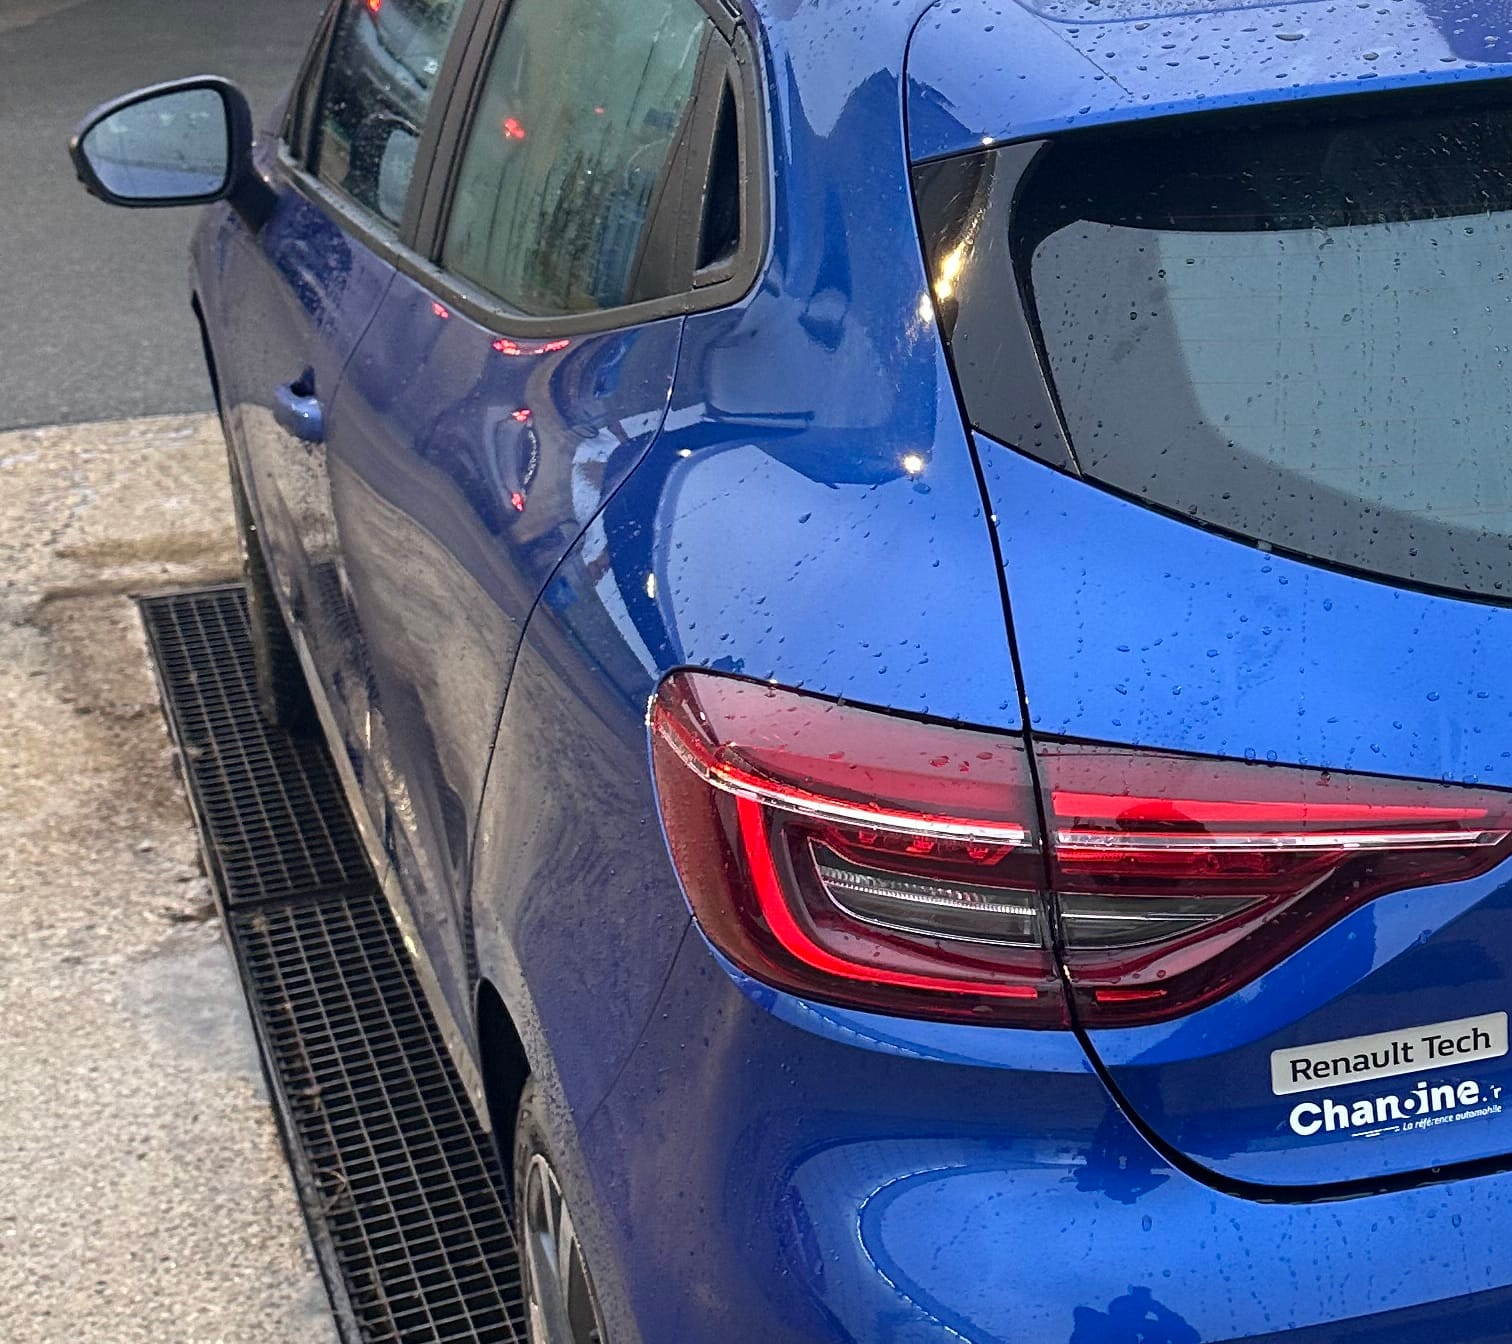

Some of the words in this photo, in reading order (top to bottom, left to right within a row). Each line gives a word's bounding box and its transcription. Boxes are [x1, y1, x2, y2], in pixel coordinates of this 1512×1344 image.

[1289, 1041, 1414, 1083] Renault
[1422, 1027, 1491, 1059] Tech
[1289, 1079, 1502, 1136] Chanoine.r
[1402, 1122, 1414, 1132] La
[1455, 1104, 1502, 1122] automobile
